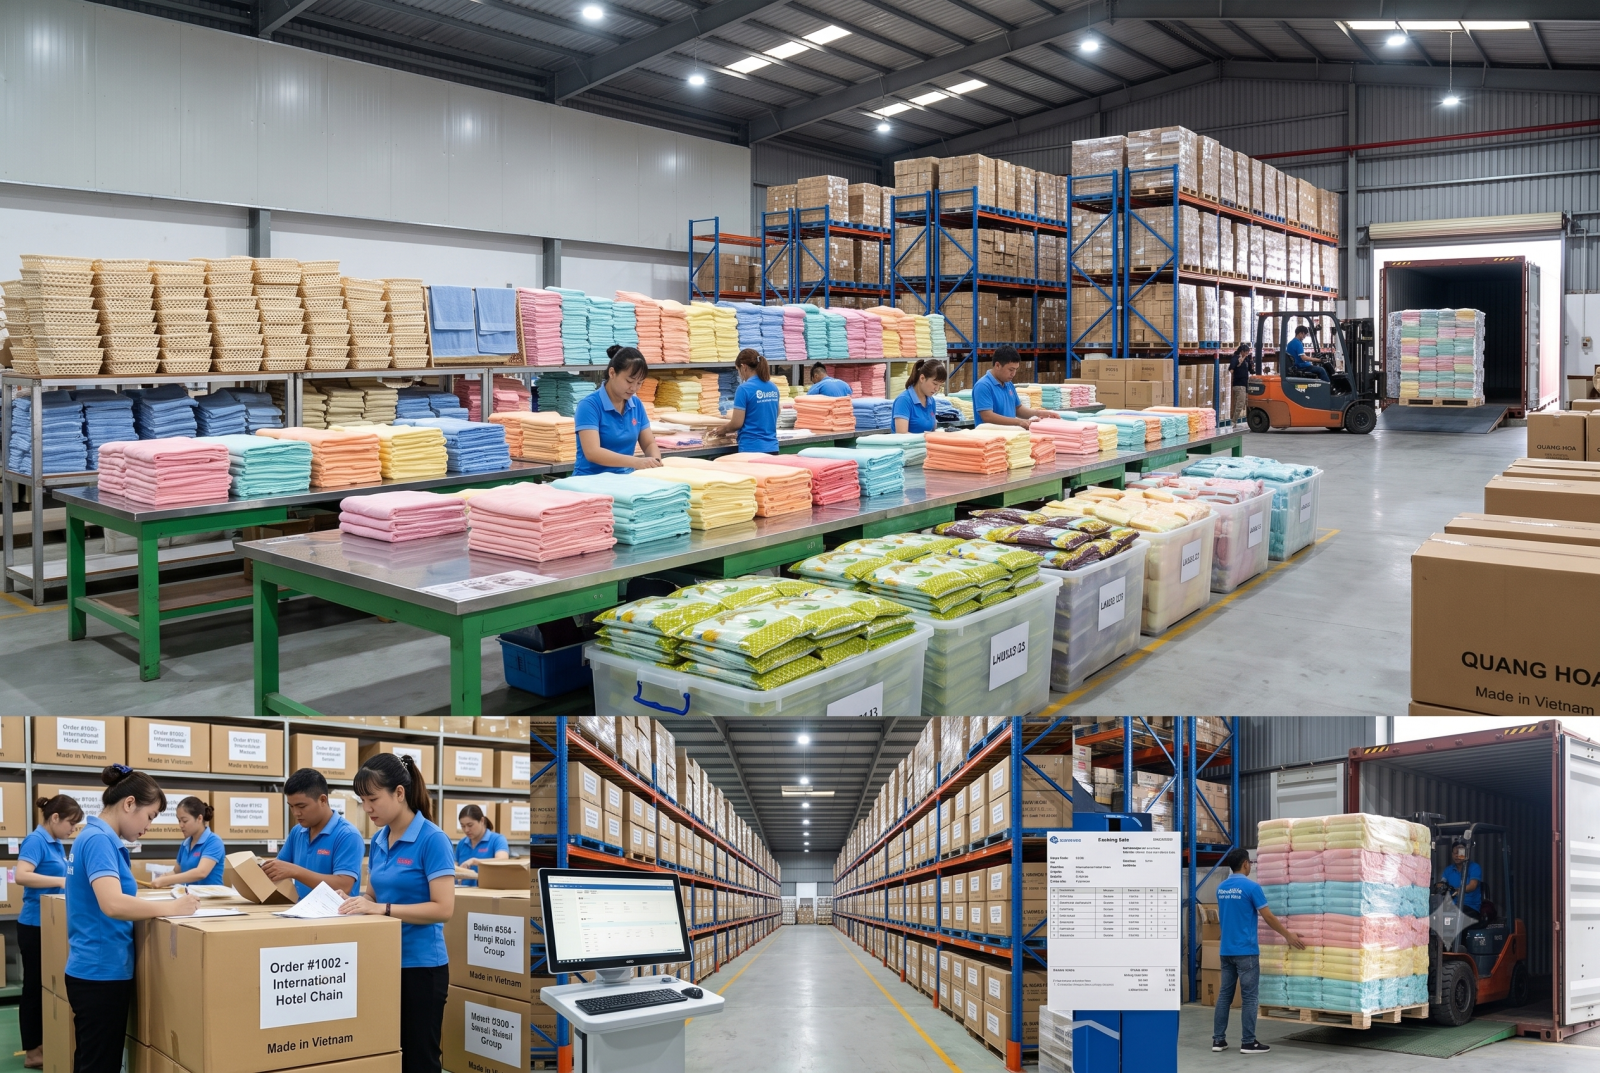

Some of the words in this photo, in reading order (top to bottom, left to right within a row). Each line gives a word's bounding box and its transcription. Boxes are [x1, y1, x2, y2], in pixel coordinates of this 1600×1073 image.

[1461, 651, 1547, 679] QUANG
[1475, 686, 1514, 702] Made
[1518, 693, 1530, 705] in
[1535, 695, 1594, 716] Vietnam
[56, 752, 74, 760] Made
[270, 961, 304, 973] Order
[307, 957, 341, 970] #1002
[273, 972, 346, 990] International
[469, 970, 486, 981] Made
[486, 973, 493, 982] in
[494, 974, 522, 988] Vietnam
[276, 992, 307, 1006] Hotel
[310, 989, 343, 1002] Chain
[267, 1041, 296, 1054] Made
[299, 1039, 309, 1050] in
[312, 1034, 354, 1047] Vietnam
[480, 1036, 502, 1050] Group
[468, 1061, 484, 1073] Made
